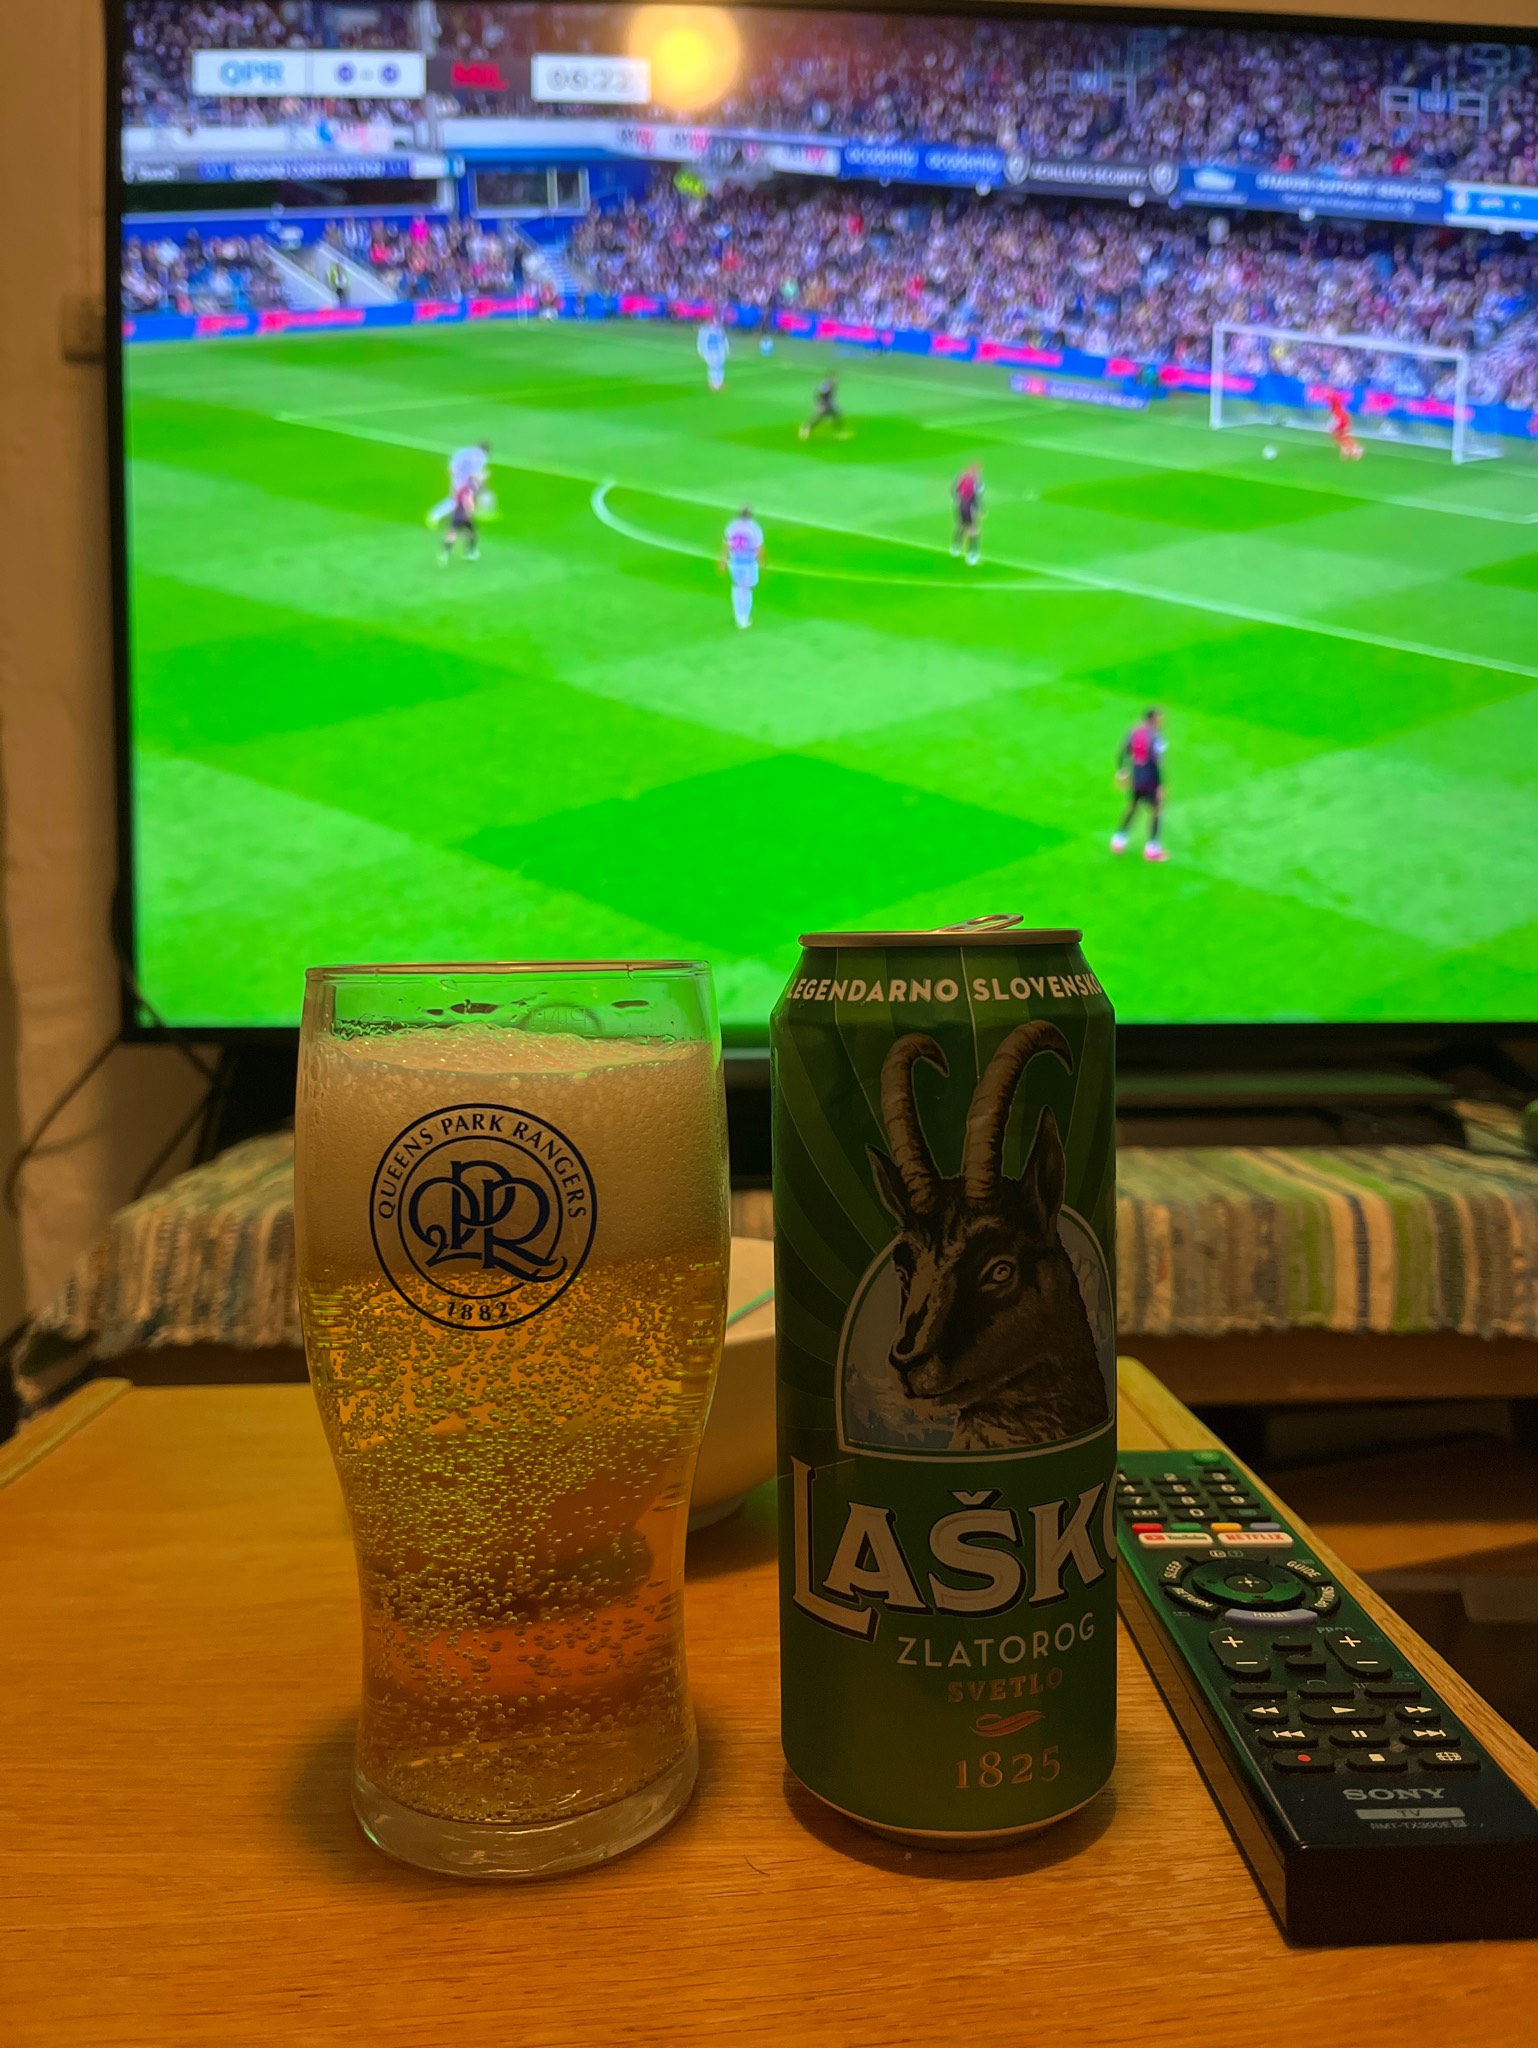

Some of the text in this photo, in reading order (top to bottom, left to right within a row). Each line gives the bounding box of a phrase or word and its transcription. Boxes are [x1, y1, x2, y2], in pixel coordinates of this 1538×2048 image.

[786, 977, 959, 1003] LEGENDARNO
[378, 1113, 587, 1219] QUEENS PARK RANGERS
[447, 1301, 508, 1321] 1882
[1226, 1533, 1284, 1541] NETFLIX
[1286, 1560, 1321, 1579] GUIDE
[1172, 1586, 1214, 1609] RETURN
[1252, 1611, 1293, 1619] HOME
[896, 1612, 1095, 1668] ZLATOROG
[947, 1667, 1064, 1703] SVETLO
[955, 1746, 1061, 1789] 1825
[1343, 1788, 1445, 1800] SONY
